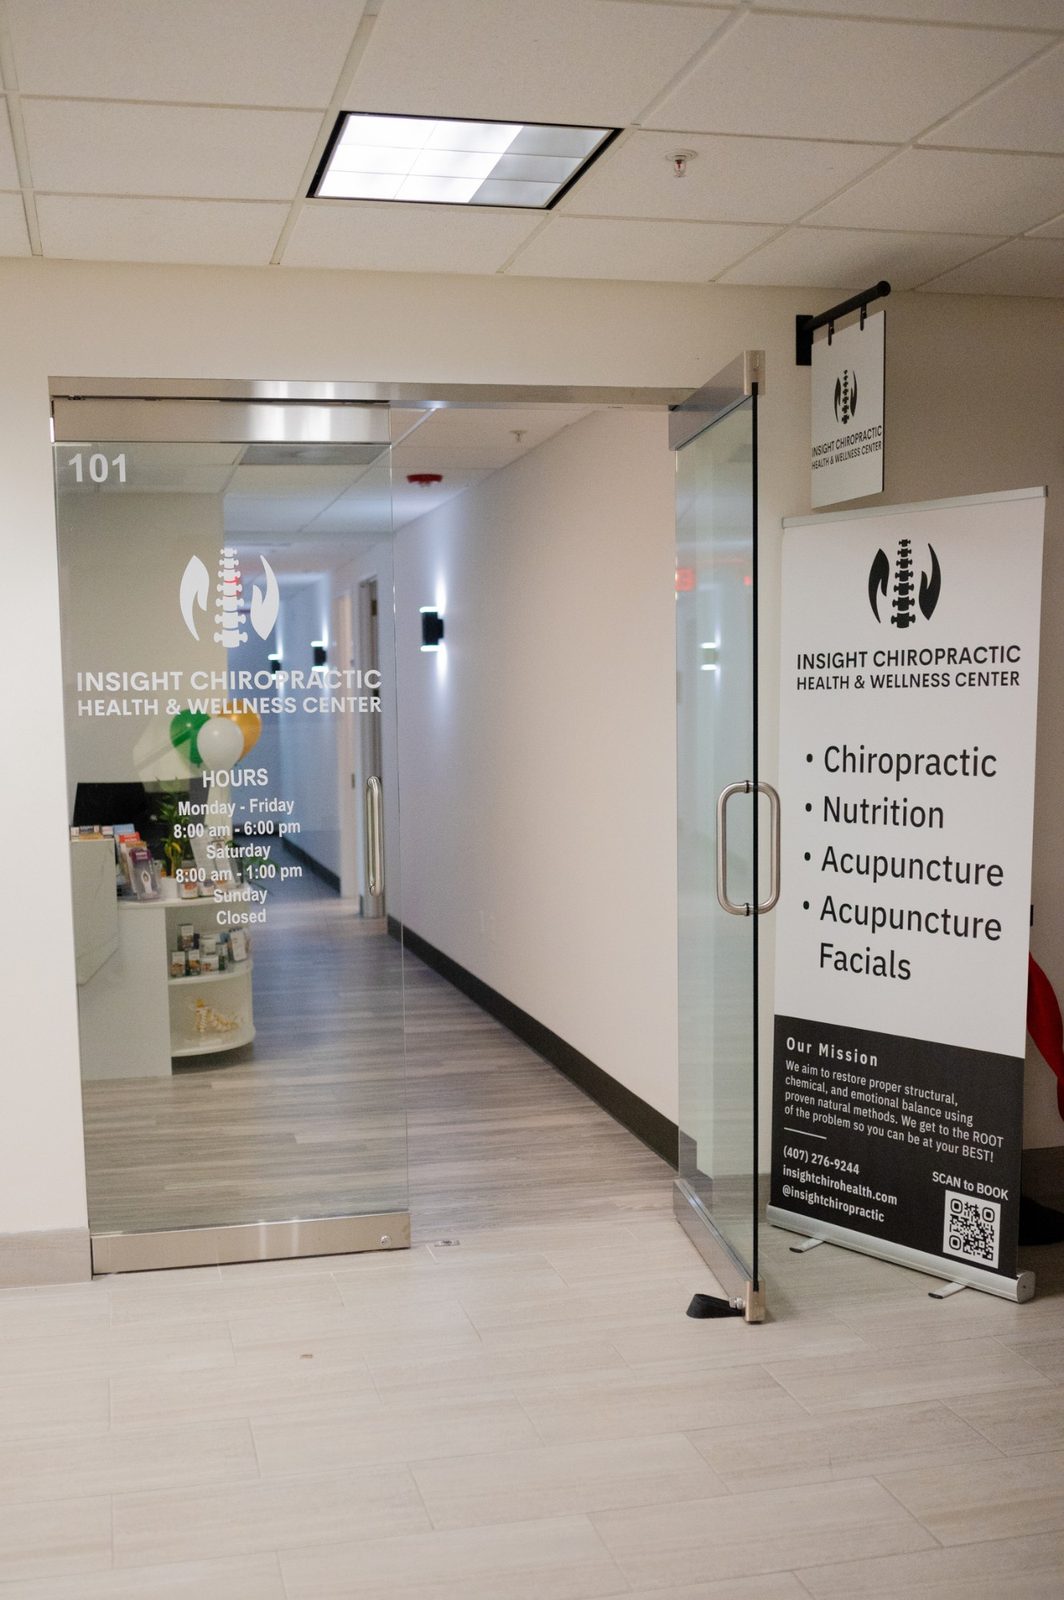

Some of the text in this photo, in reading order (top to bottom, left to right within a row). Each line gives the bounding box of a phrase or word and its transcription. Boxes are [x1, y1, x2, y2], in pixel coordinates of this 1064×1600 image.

[812, 425, 882, 457] INSIGHT CHIROPRACTIC
[812, 457, 829, 469] HEALTH
[835, 448, 860, 463] WELLNESS
[862, 441, 881, 455] CENTER
[69, 454, 127, 482] 101
[797, 645, 1021, 670] INSIGHT CHIROPRACTIC
[77, 670, 382, 692] INSIGHT CHIROPRACTIC
[797, 671, 1020, 690] HEALTH & WELLNESS CENTER
[78, 697, 382, 716] HEALTH & WELLNESS CENTER
[202, 768, 268, 787] HOURS
[824, 745, 997, 782] Chiropractic
[178, 801, 236, 817] Monday
[250, 798, 294, 815] Friday
[824, 796, 943, 828] Nutrition
[174, 823, 204, 838] 8:00
[209, 826, 230, 836] am
[244, 820, 274, 835] 6:00
[279, 821, 300, 837] pm
[207, 844, 271, 860] Saturday
[821, 846, 1004, 887] Acupuncture
[176, 868, 206, 883] 8:00
[211, 871, 232, 881] am
[246, 864, 276, 879] 1:00
[281, 866, 302, 881] pm
[214, 889, 267, 904] Sunday
[216, 909, 266, 924] Closed
[820, 896, 1001, 941] Acupuncture
[820, 942, 911, 980] Facials
[786, 1037, 878, 1067] Our Mission
[786, 1060, 959, 1107] We aim to restore proper structural,
[785, 1075, 973, 1127] chemical, and emotional balance using
[785, 1091, 1004, 1148] proven natural methods. We get to the ROOT
[785, 1104, 994, 1163] of the problem so you can be at your BEST!
[783, 1145, 859, 1175] (407) 276-9244
[783, 1166, 897, 1205] insightchirohealth.com
[932, 1171, 1008, 1200] SCAN to BOOK
[783, 1185, 885, 1223] @insightchiropractic
